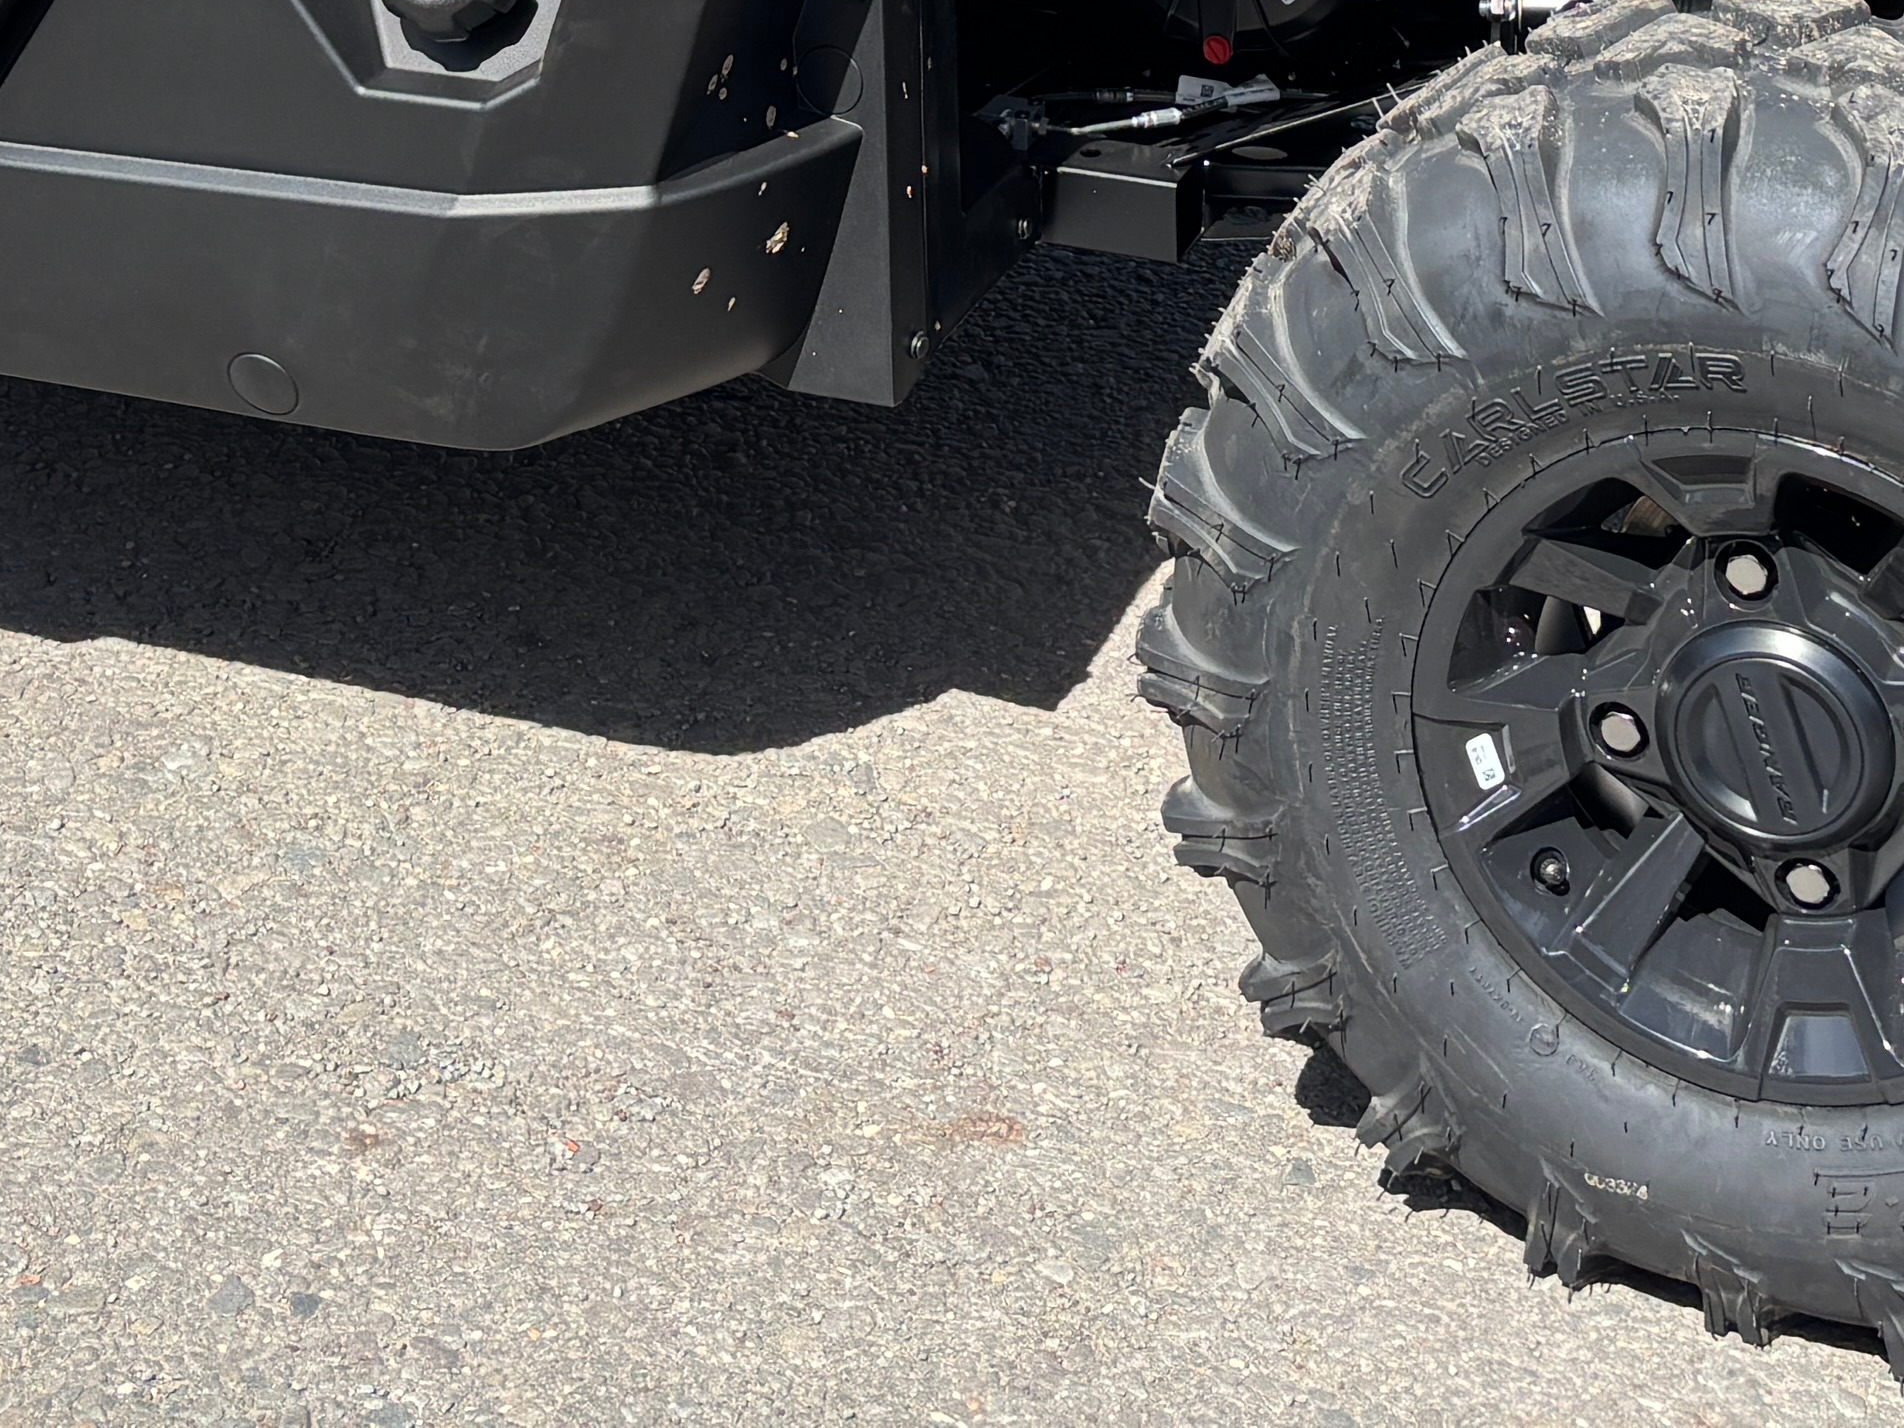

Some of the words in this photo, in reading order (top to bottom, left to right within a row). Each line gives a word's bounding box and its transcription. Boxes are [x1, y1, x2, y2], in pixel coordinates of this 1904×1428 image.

[1399, 351, 1748, 498] CARLSTAR
[1474, 410, 1570, 467] DESIGNED
[1580, 398, 1603, 418] IN
[1735, 672, 1798, 826] RANGER
[1766, 1130, 1826, 1151] ONLY
[1840, 1133, 1884, 1152] USE
